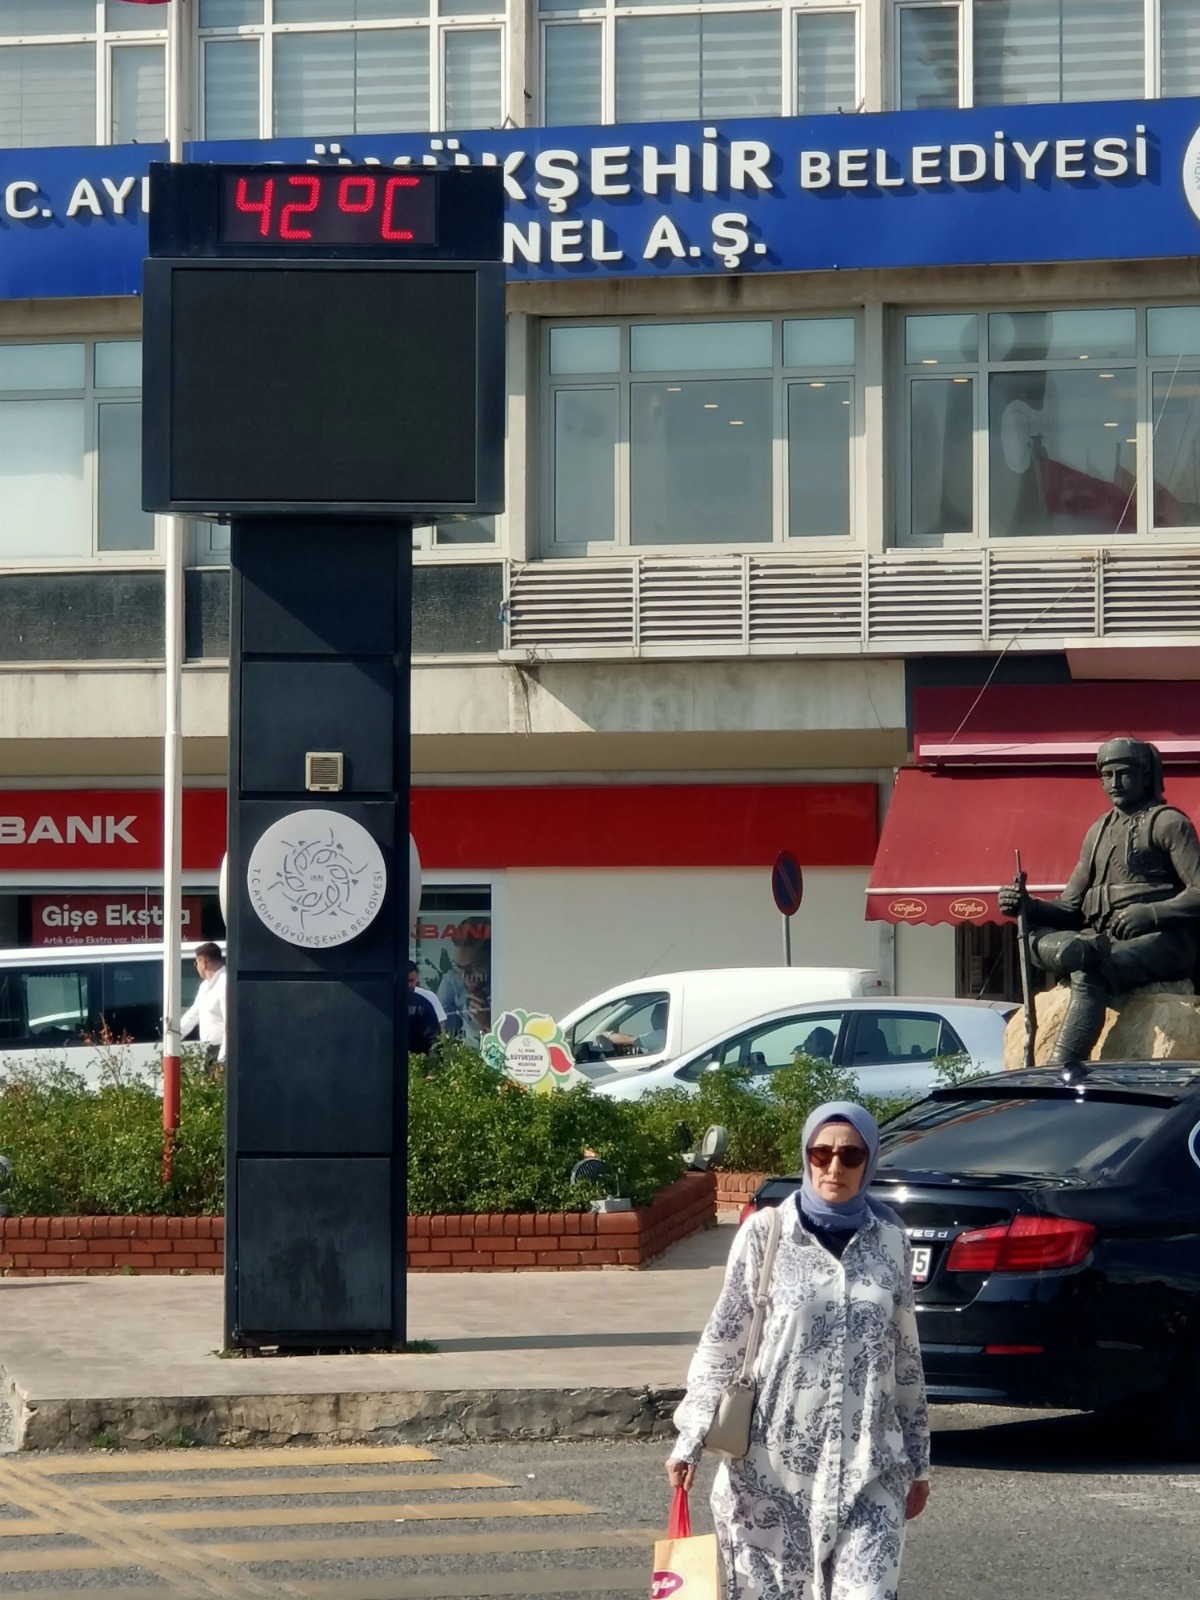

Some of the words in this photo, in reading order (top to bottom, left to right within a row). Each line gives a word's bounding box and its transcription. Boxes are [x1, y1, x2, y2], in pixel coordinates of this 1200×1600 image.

[66, 176, 150, 216] AY
[800, 124, 1147, 189] BELEDİYESİ
[42, 903, 98, 932] Gişe
[105, 903, 191, 926] Eksta
